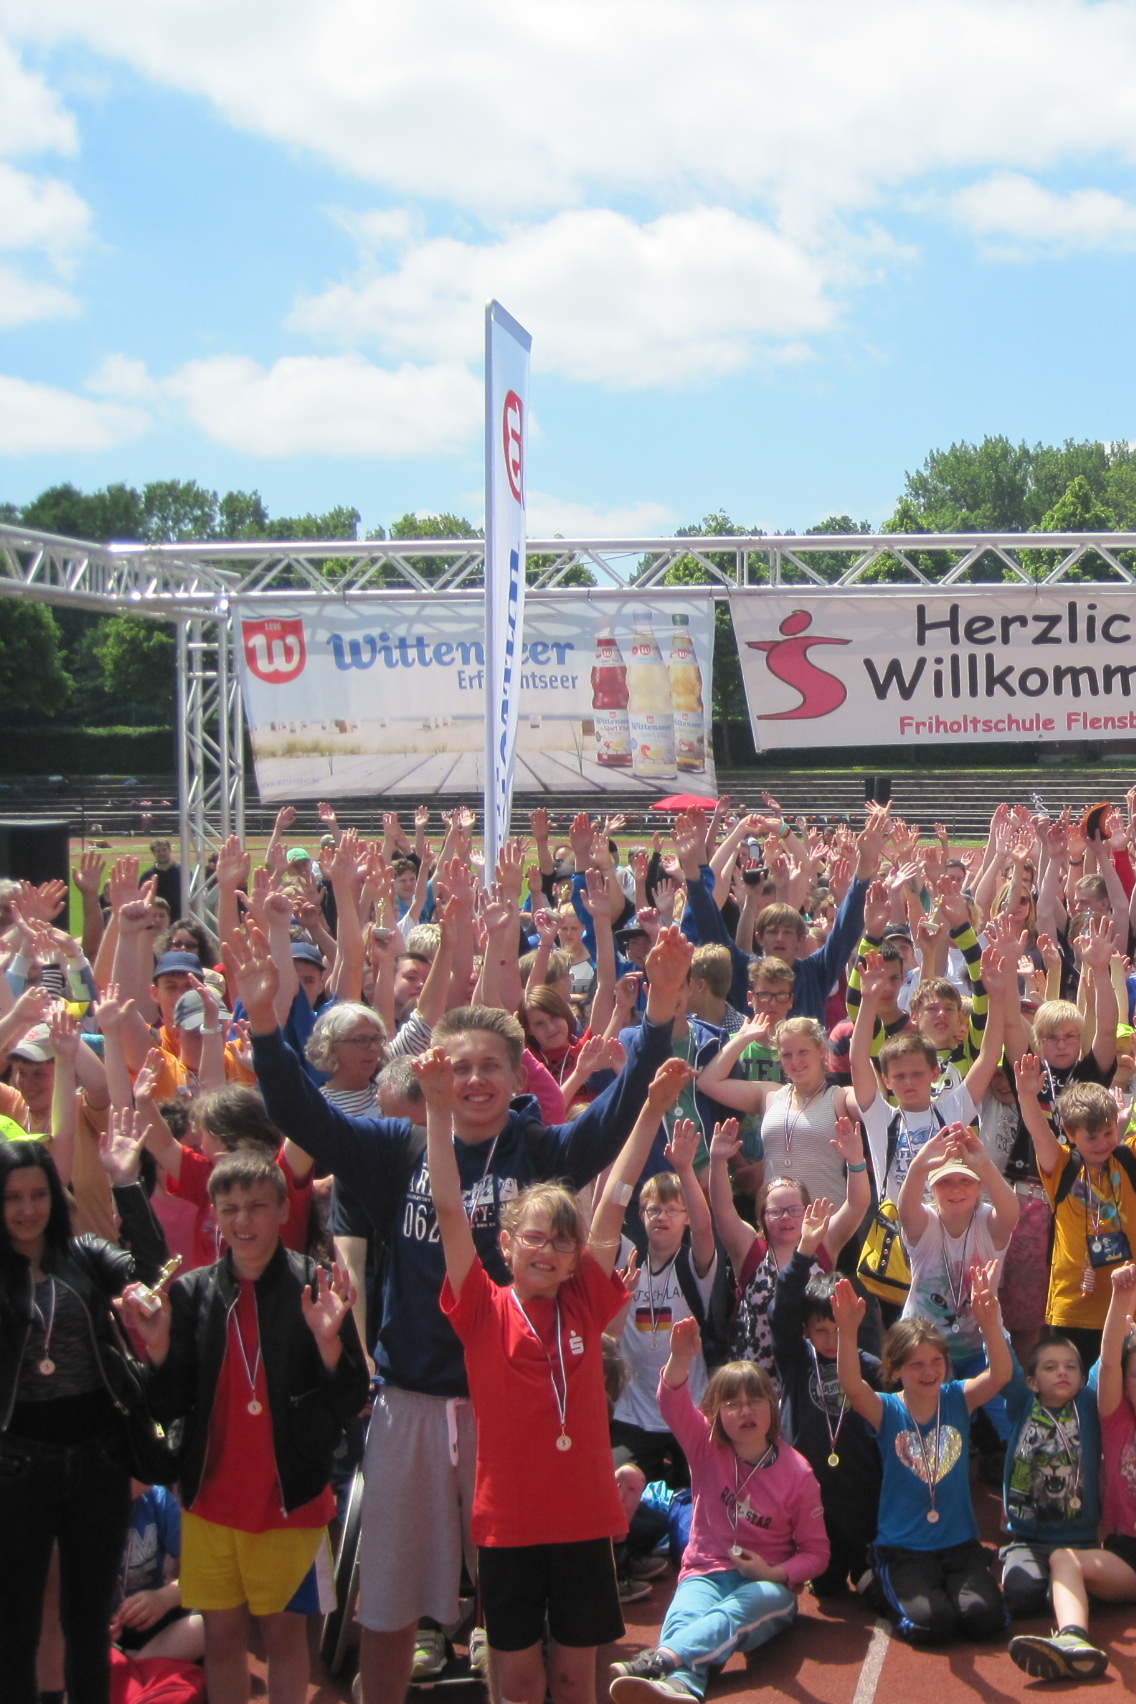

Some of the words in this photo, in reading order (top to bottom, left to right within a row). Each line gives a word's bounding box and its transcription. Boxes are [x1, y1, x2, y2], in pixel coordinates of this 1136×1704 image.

[326, 632, 575, 671] Wittener
[457, 669, 578, 690] Erfhtseer
[899, 713, 1055, 735] Friholtschule
